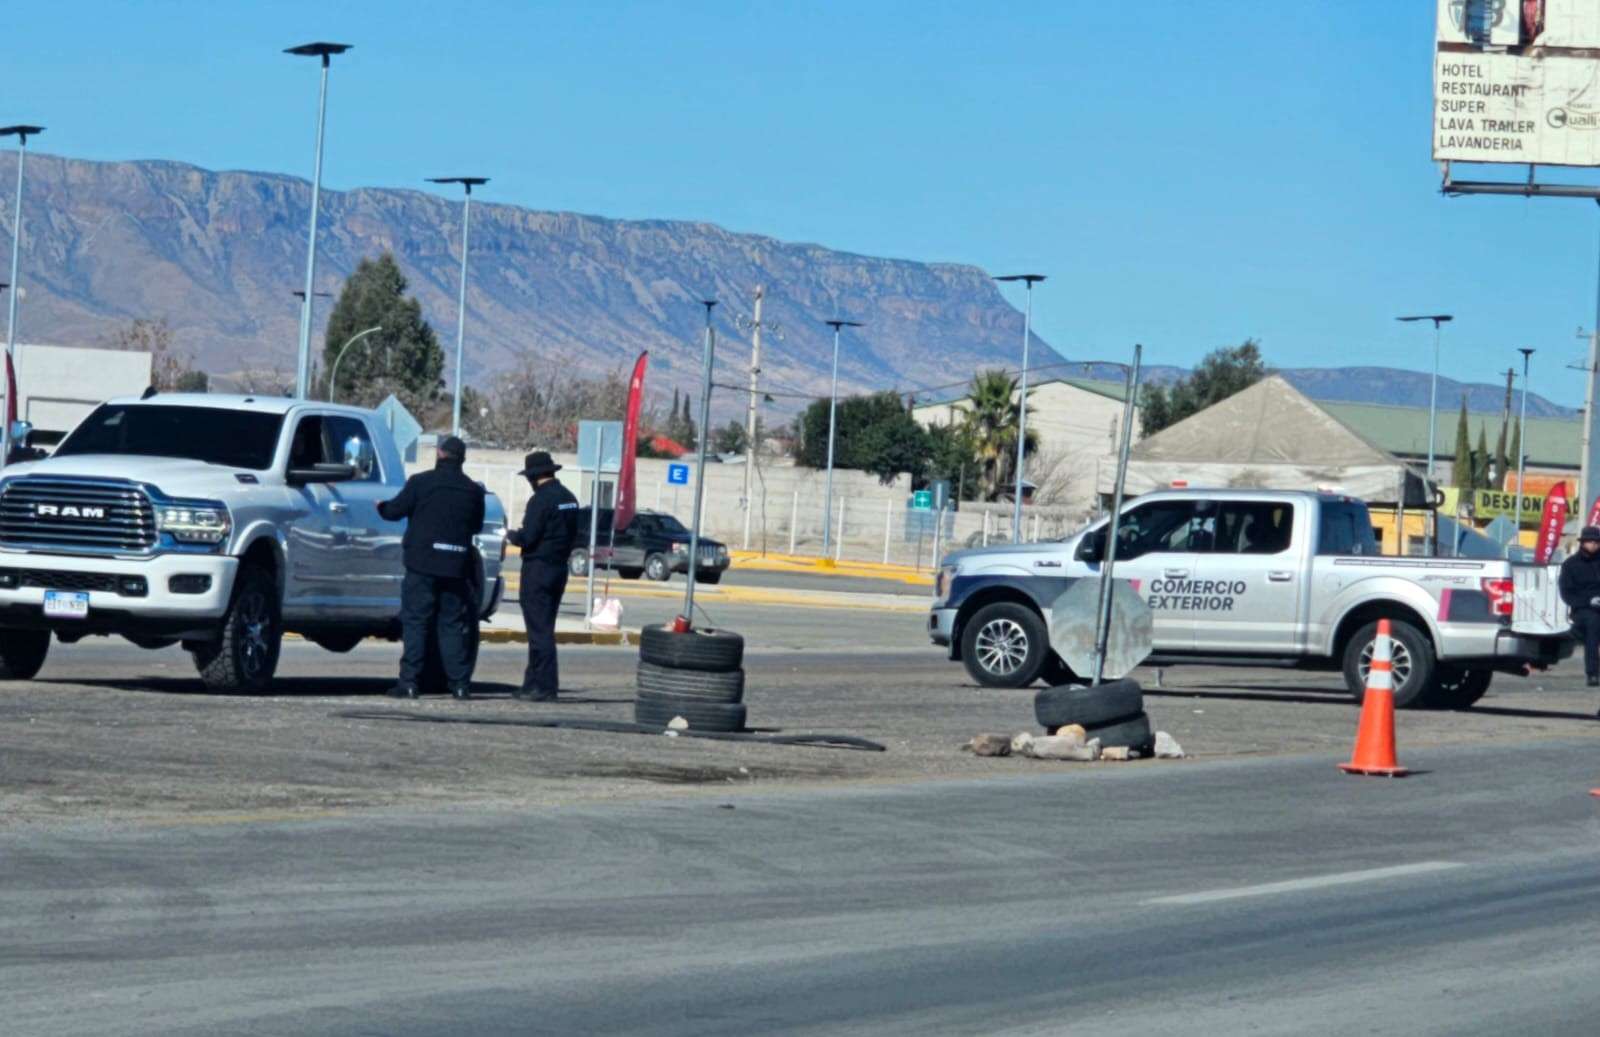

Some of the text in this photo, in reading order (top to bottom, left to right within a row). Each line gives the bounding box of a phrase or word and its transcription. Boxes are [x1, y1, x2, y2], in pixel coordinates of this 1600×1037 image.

[1442, 64, 1483, 78] HOTEL
[1441, 82, 1527, 97] RESTAURANT
[1441, 100, 1485, 113] SUPER
[1440, 119, 1535, 133] LAVA TRAILER
[1440, 135, 1523, 150] LAVANDERIA
[672, 468, 683, 481] E
[38, 505, 104, 518] RAM
[1150, 579, 1247, 595] COMERCIO
[1147, 595, 1234, 611] EXTERIOR
